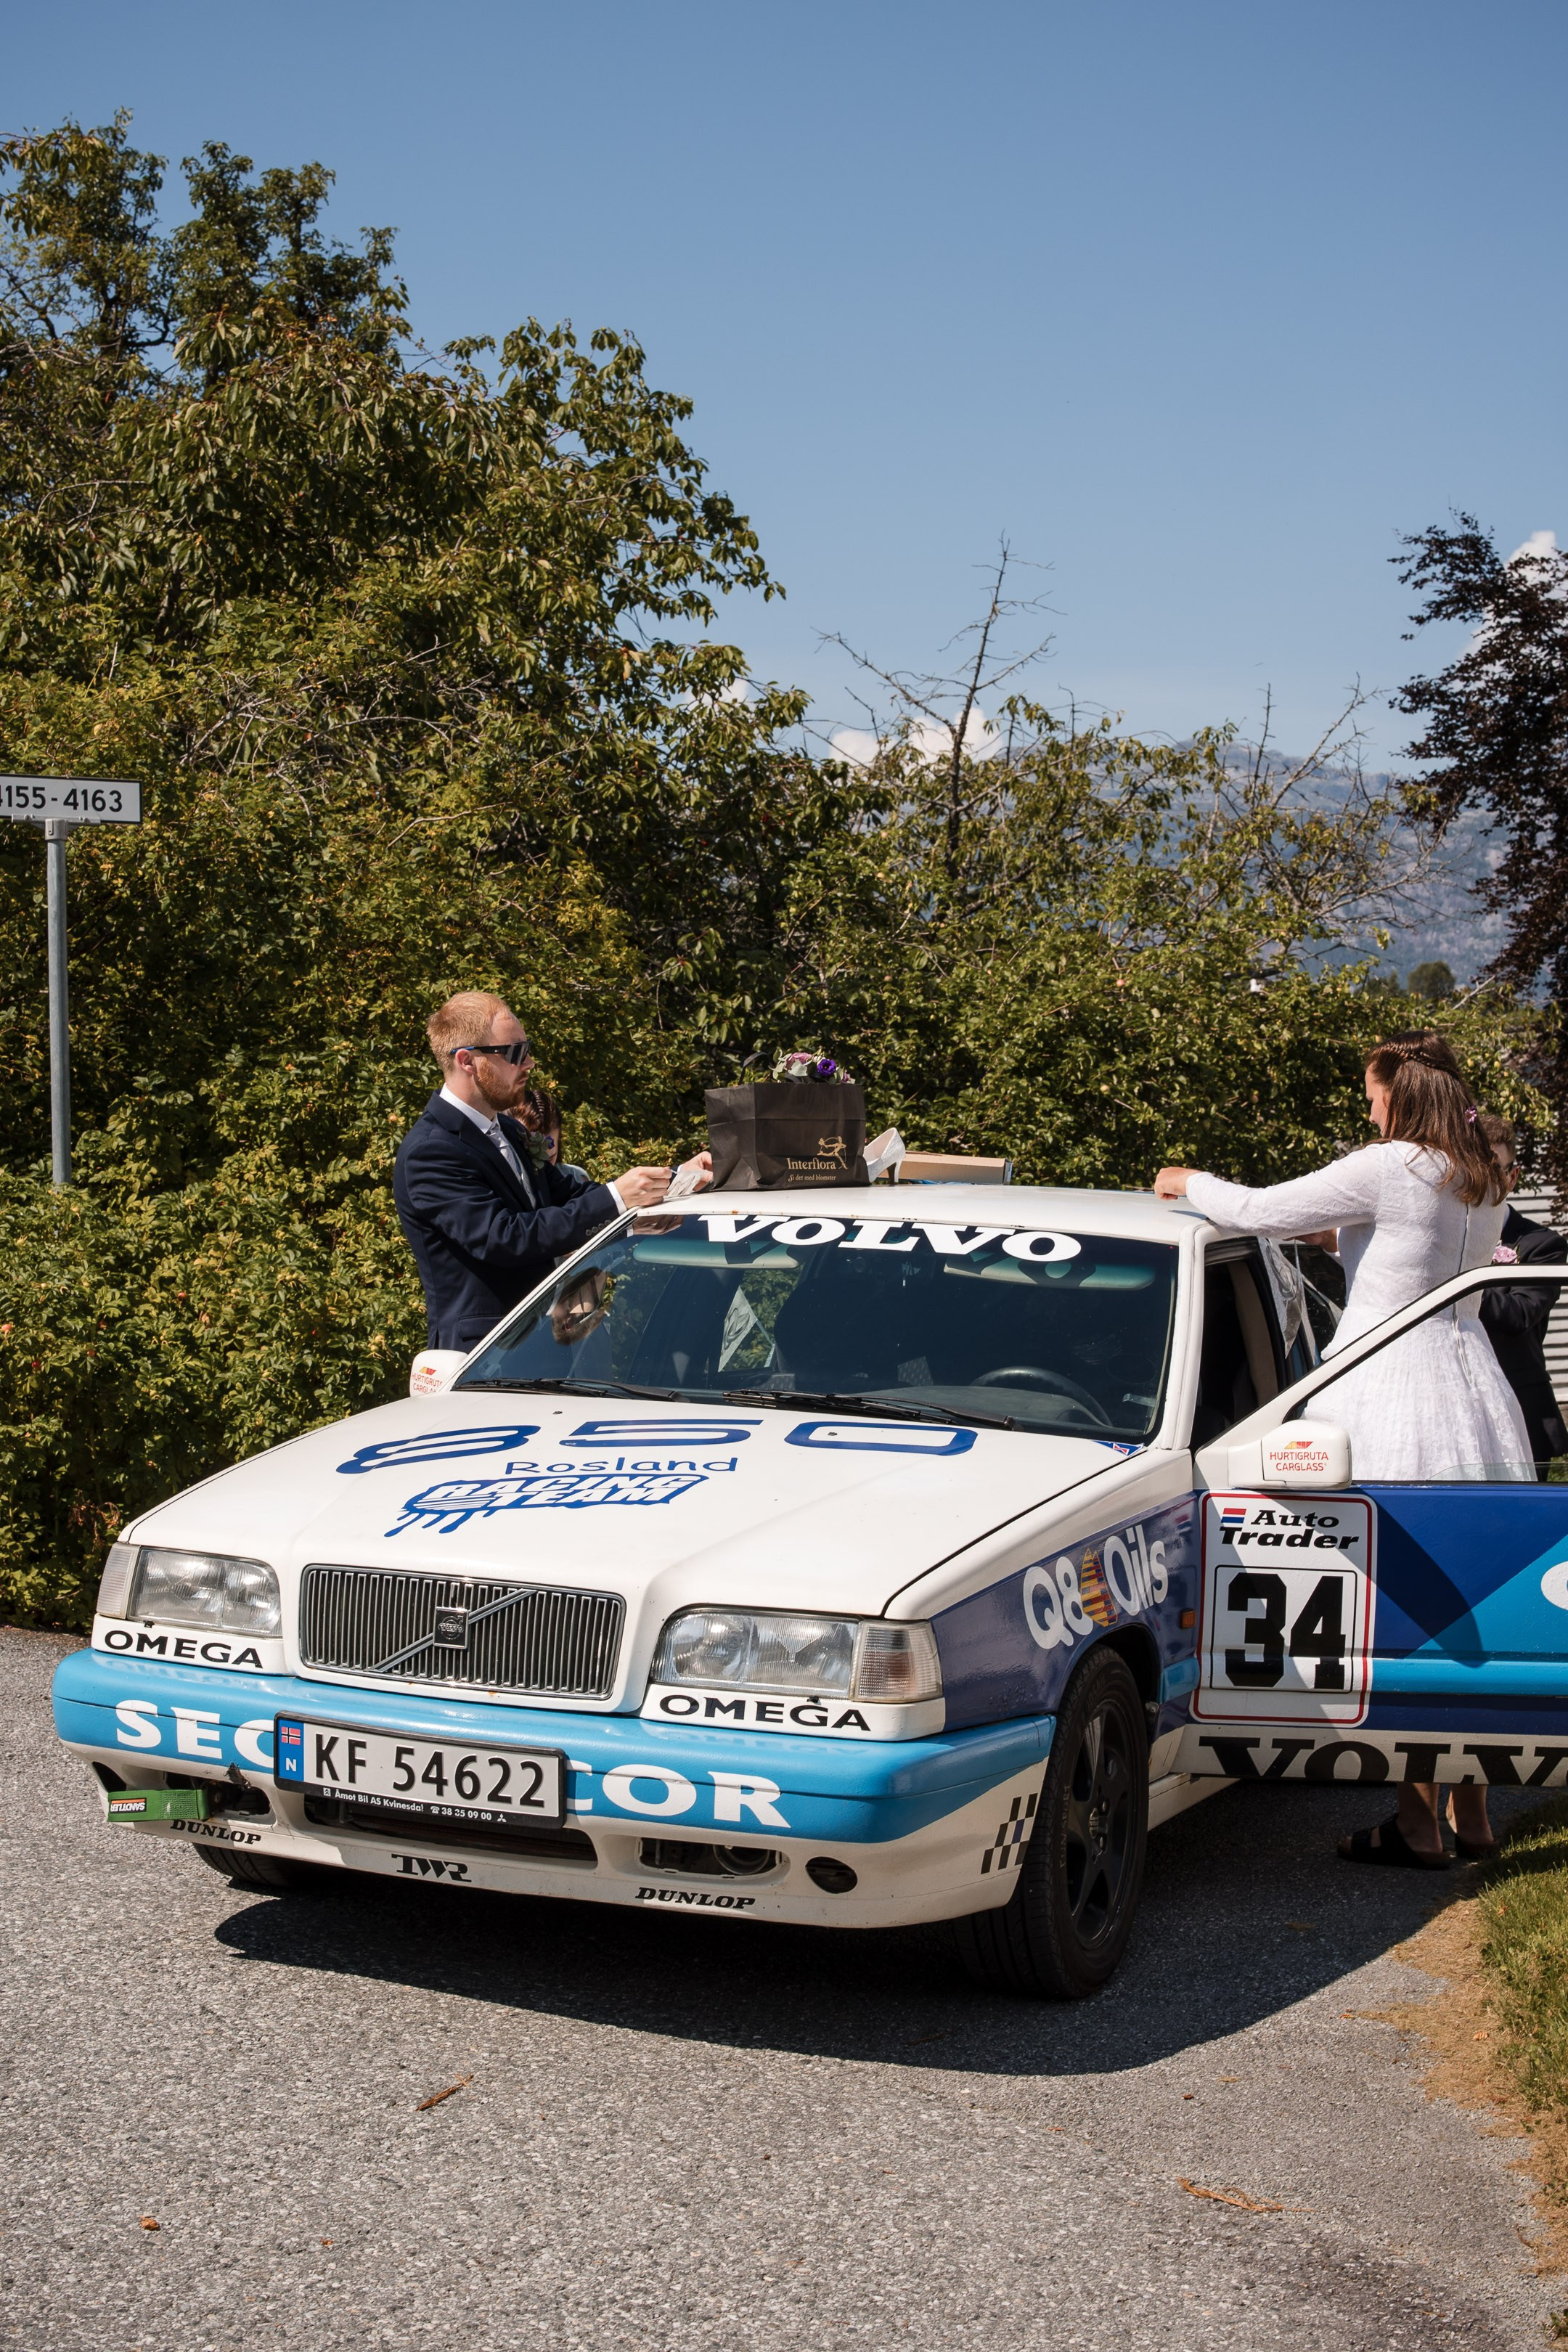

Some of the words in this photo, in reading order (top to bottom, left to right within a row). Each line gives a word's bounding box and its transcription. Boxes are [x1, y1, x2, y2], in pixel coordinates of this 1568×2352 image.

[0, 784, 123, 812] 155-4163
[786, 1157, 836, 1169] Interflora
[697, 1214, 1082, 1262] VOLVO
[335, 1419, 978, 1474] 850
[1270, 1452, 1329, 1461] HURTIGRUTA
[505, 1456, 738, 1475] Rosland
[425, 1475, 694, 1499] RACING
[487, 1487, 678, 1508] TEAM
[1251, 1509, 1339, 1528] Auto
[1219, 1526, 1360, 1550] Trader
[1023, 1556, 1093, 1650] Q8
[1103, 1524, 1169, 1617] Oils
[1225, 1572, 1347, 1690] 34
[105, 1630, 264, 1669] OMEGA
[659, 1694, 872, 1731] OMEGA
[285, 1757, 296, 1773] N
[315, 1733, 367, 1784] KF
[393, 1745, 545, 1809] 54622
[1199, 1736, 1568, 1787] VOLV
[110, 1802, 145, 1813] SANDTLER
[335, 1789, 356, 1800] Åmot
[358, 1794, 369, 1803] Bil
[370, 1797, 381, 1805] AS
[383, 1799, 424, 1812] Kvinesdal
[441, 1807, 452, 1816] 38
[467, 1810, 478, 1819] 09
[481, 1812, 491, 1821] 00
[170, 1819, 261, 1845] DUNLOP
[391, 1853, 472, 1883] TWR
[634, 1887, 756, 1909] DUNLOP
